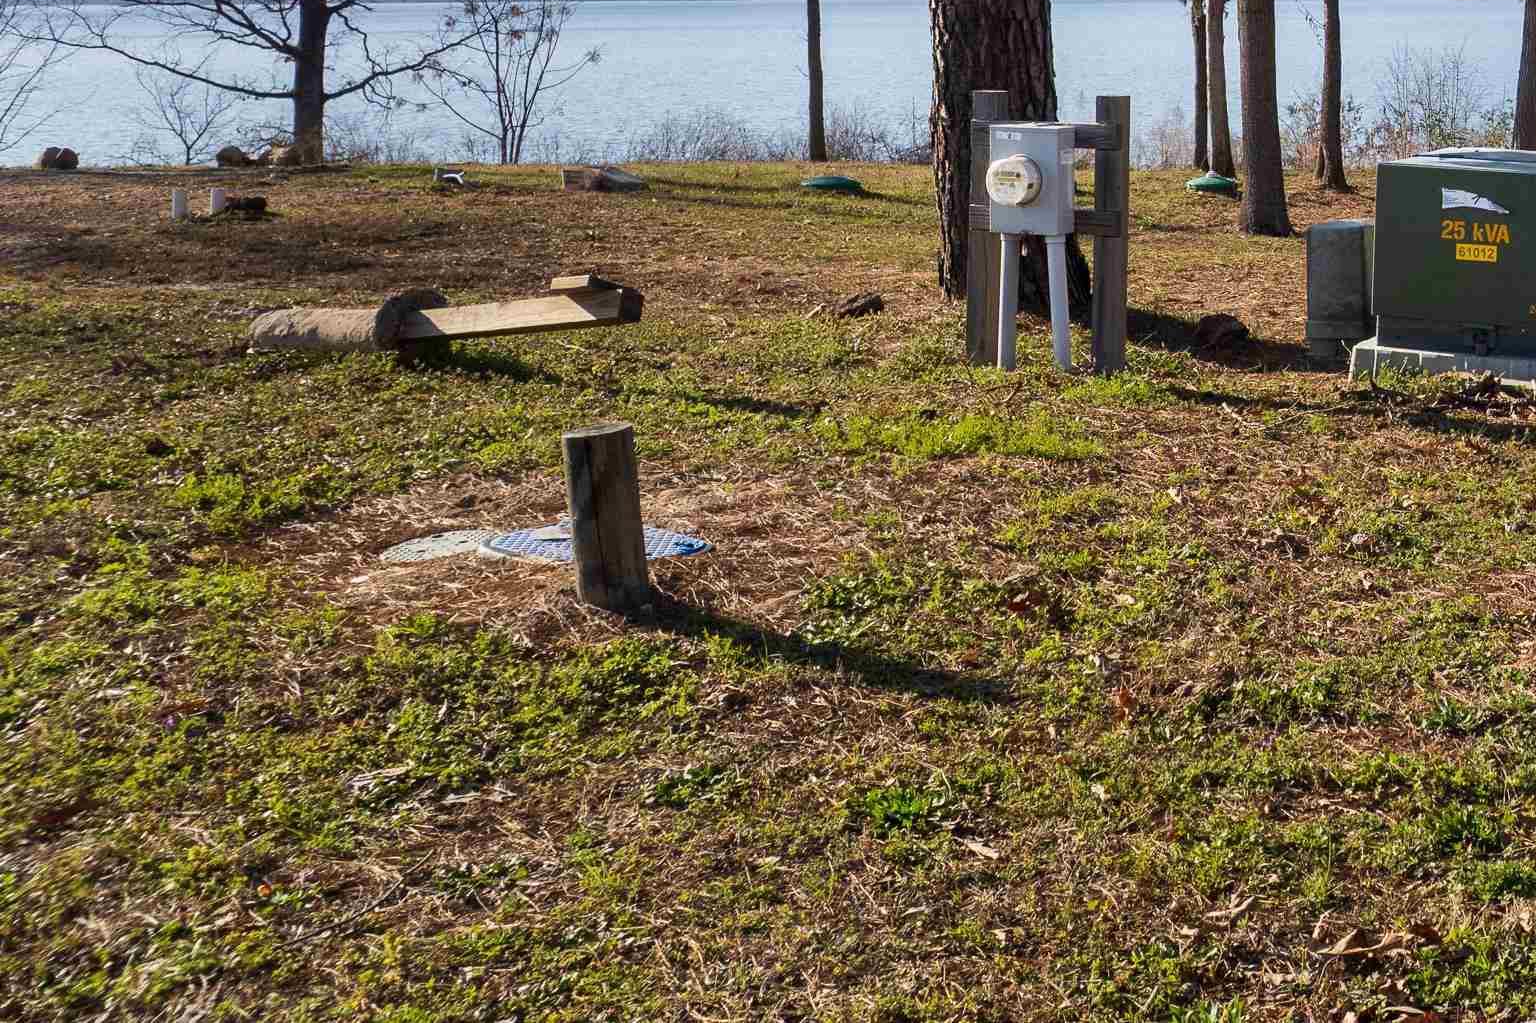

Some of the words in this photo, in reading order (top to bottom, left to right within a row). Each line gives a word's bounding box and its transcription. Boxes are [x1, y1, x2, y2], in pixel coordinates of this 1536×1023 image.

[1440, 219, 1465, 241] 25
[1472, 222, 1510, 245] kVA
[1458, 246, 1495, 259] 61012
